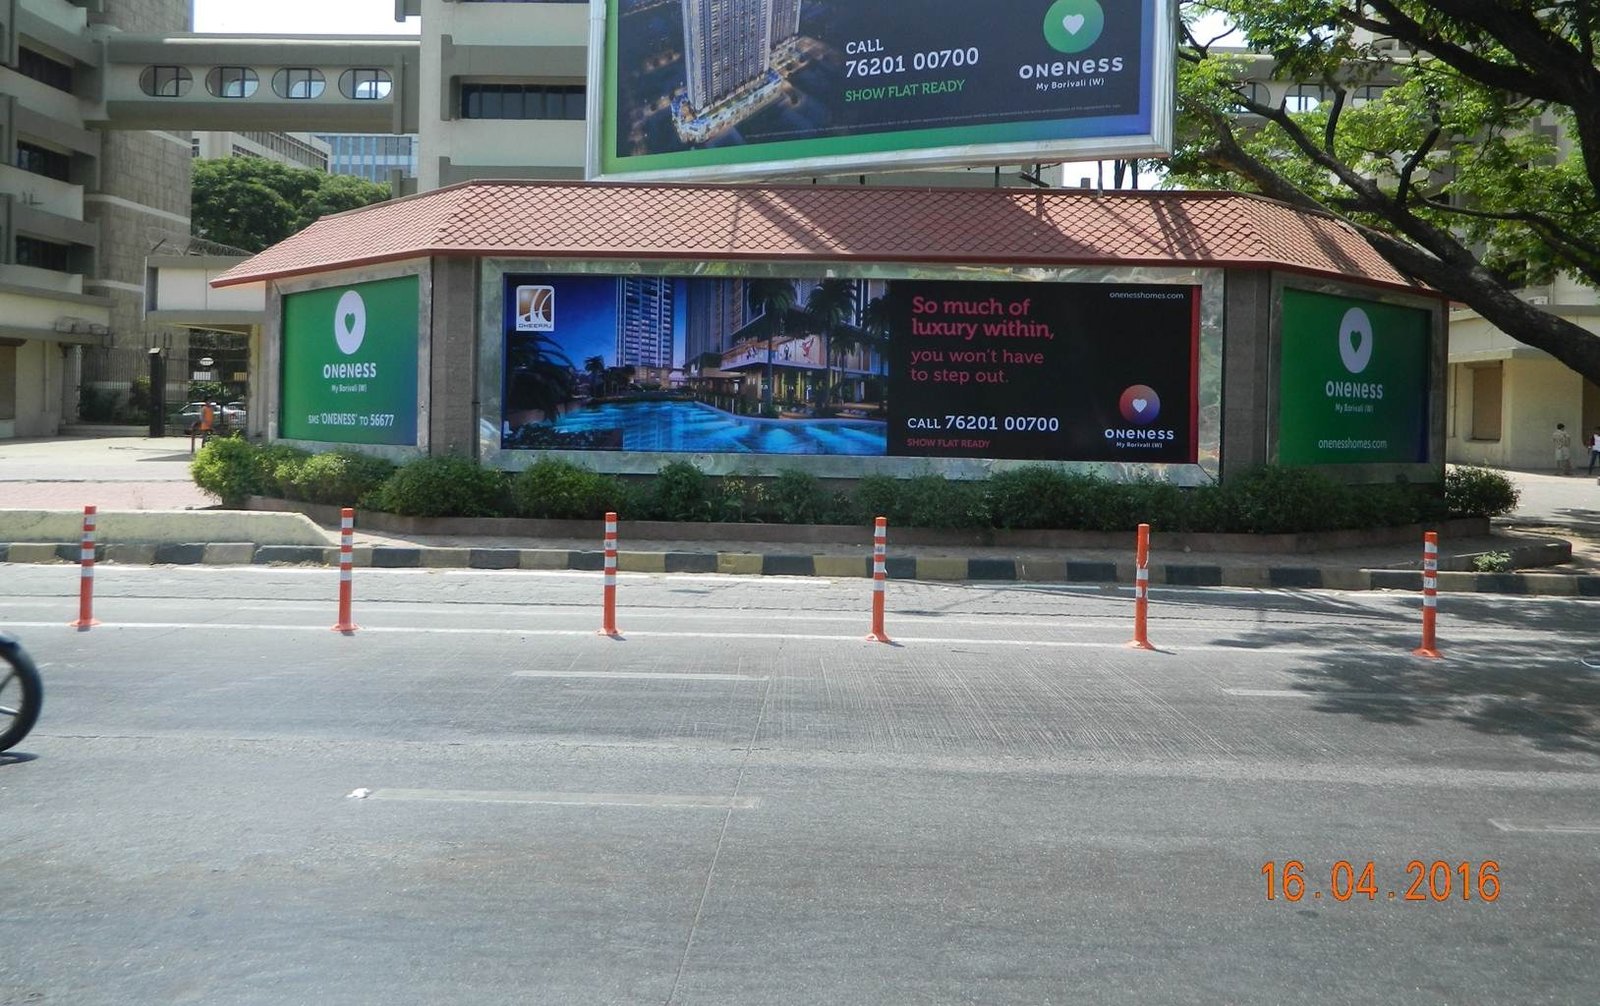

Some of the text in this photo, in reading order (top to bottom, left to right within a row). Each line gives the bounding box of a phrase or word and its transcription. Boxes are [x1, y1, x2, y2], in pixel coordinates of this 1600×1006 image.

[846, 39, 884, 54] CALL
[845, 47, 979, 78] 76201 00700
[845, 79, 966, 102] SHOW FLAT READY
[1036, 78, 1105, 91] My Borivali (W)
[1109, 291, 1184, 300] onenesshomes.com
[912, 296, 1031, 316] So much of
[912, 318, 1055, 341] luxury within,
[911, 350, 1045, 365] you won't have
[910, 368, 1010, 385] to step out.
[370, 413, 395, 427] 56677
[907, 415, 1060, 432] CALL 76201 00700
[906, 438, 991, 449] SHOW FLAT READY
